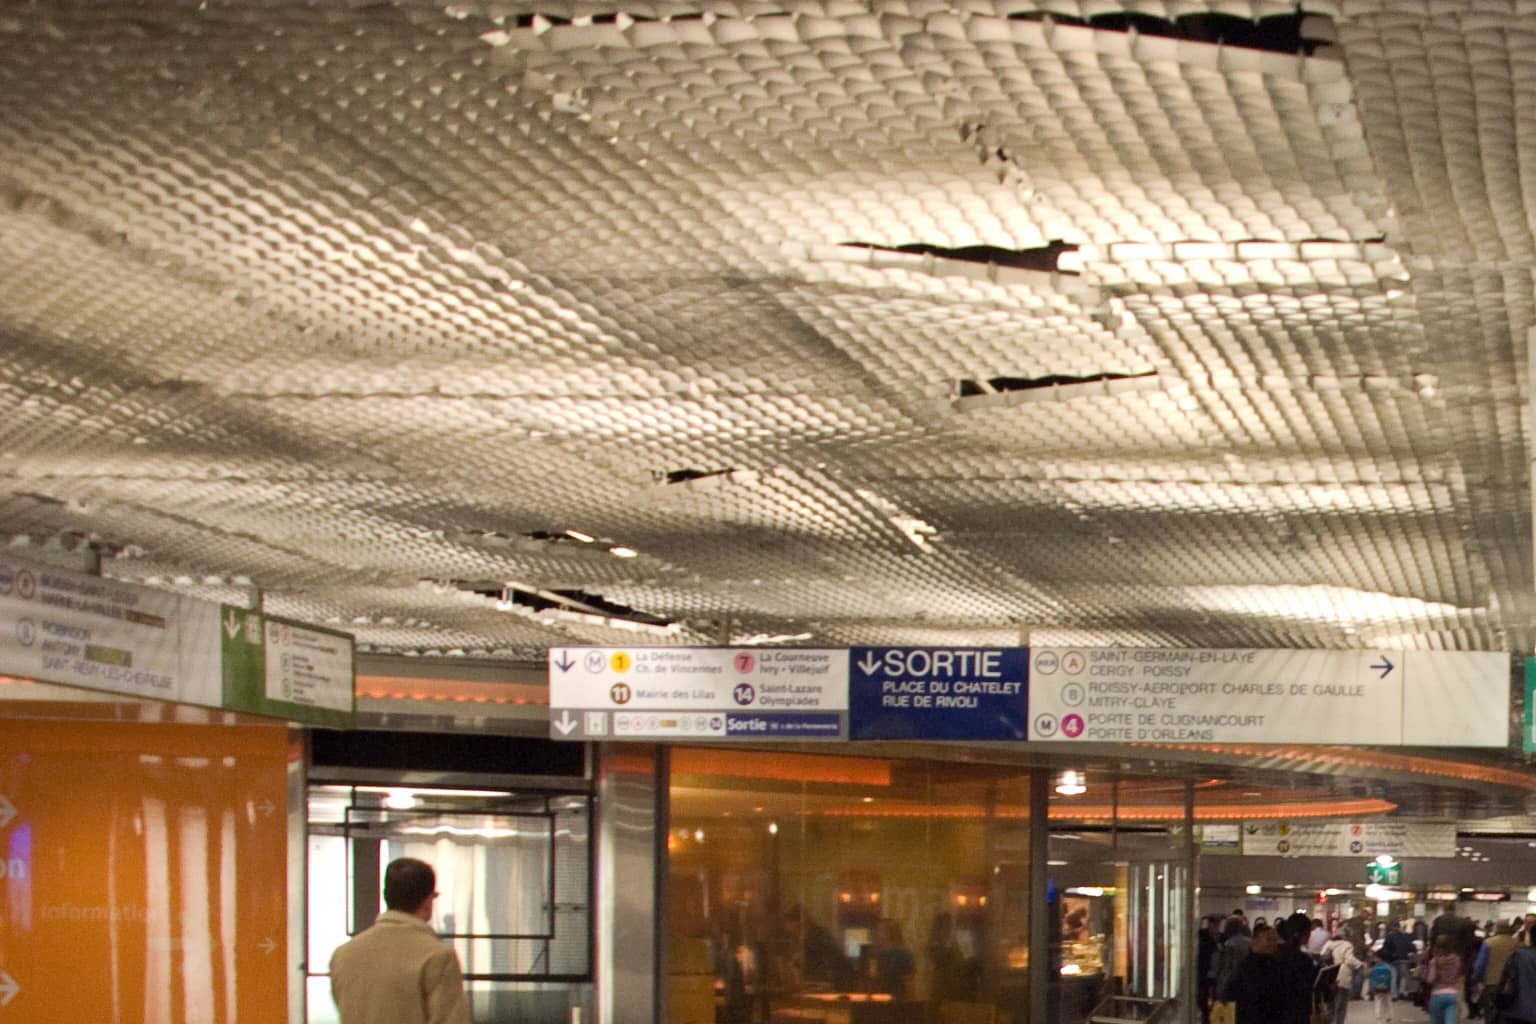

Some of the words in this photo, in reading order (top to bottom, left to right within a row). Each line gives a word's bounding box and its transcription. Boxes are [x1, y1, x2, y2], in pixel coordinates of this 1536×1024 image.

[635, 652, 648, 661] La
[651, 651, 692, 661] Défense
[760, 653, 772, 662] La
[655, 664, 667, 673] de
[883, 651, 1003, 677] SORTIE
[1089, 665, 1134, 676] CERGY
[1144, 666, 1191, 677] POISSY
[882, 681, 925, 693] PLACE
[930, 682, 949, 693] DU
[953, 682, 1021, 694] CHATELET
[1222, 683, 1284, 695] CHARLES
[1289, 684, 1307, 695] DE
[1313, 684, 1366, 696] GAULLE
[636, 689, 669, 699] Mairie
[672, 690, 689, 699] des
[692, 690, 715, 700] Lilas
[882, 696, 910, 707] RUE
[913, 696, 932, 707] DE
[936, 696, 978, 708] RIVOLI
[1088, 698, 1176, 708] MITRY-CLAYE
[727, 718, 767, 731] Sortie
[1088, 714, 1132, 725] PORTE
[1138, 714, 1153, 725] DE
[1161, 714, 1264, 726] CLIGNANCOURT
[1088, 728, 1132, 739] PORTE
[1138, 728, 1214, 740] D'ORLEANS
